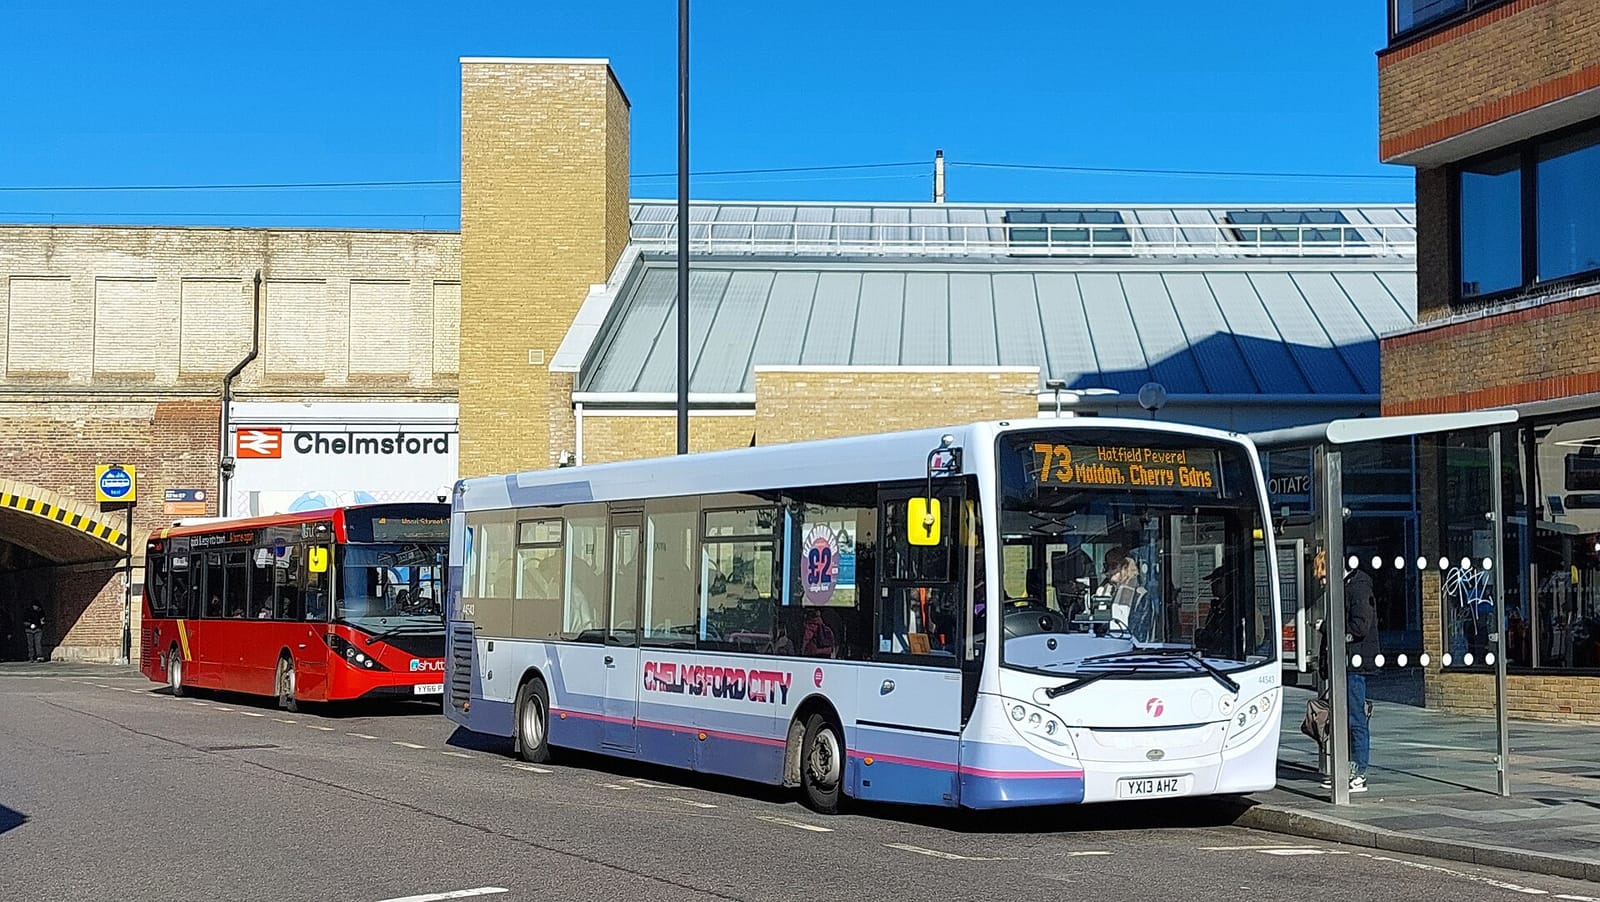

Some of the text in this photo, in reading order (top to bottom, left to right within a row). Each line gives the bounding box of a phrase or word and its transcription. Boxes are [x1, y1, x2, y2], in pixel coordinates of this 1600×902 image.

[294, 431, 449, 454] Chelmsford
[1034, 444, 1073, 483] 73
[1096, 446, 1186, 465] Hatfield Peverel
[1075, 464, 1213, 488] Maldon, Cherry Gdns
[808, 547, 832, 584] £2
[643, 661, 792, 705] CHELMSFORD CITY
[1128, 779, 1178, 794] YX13 AHZ
